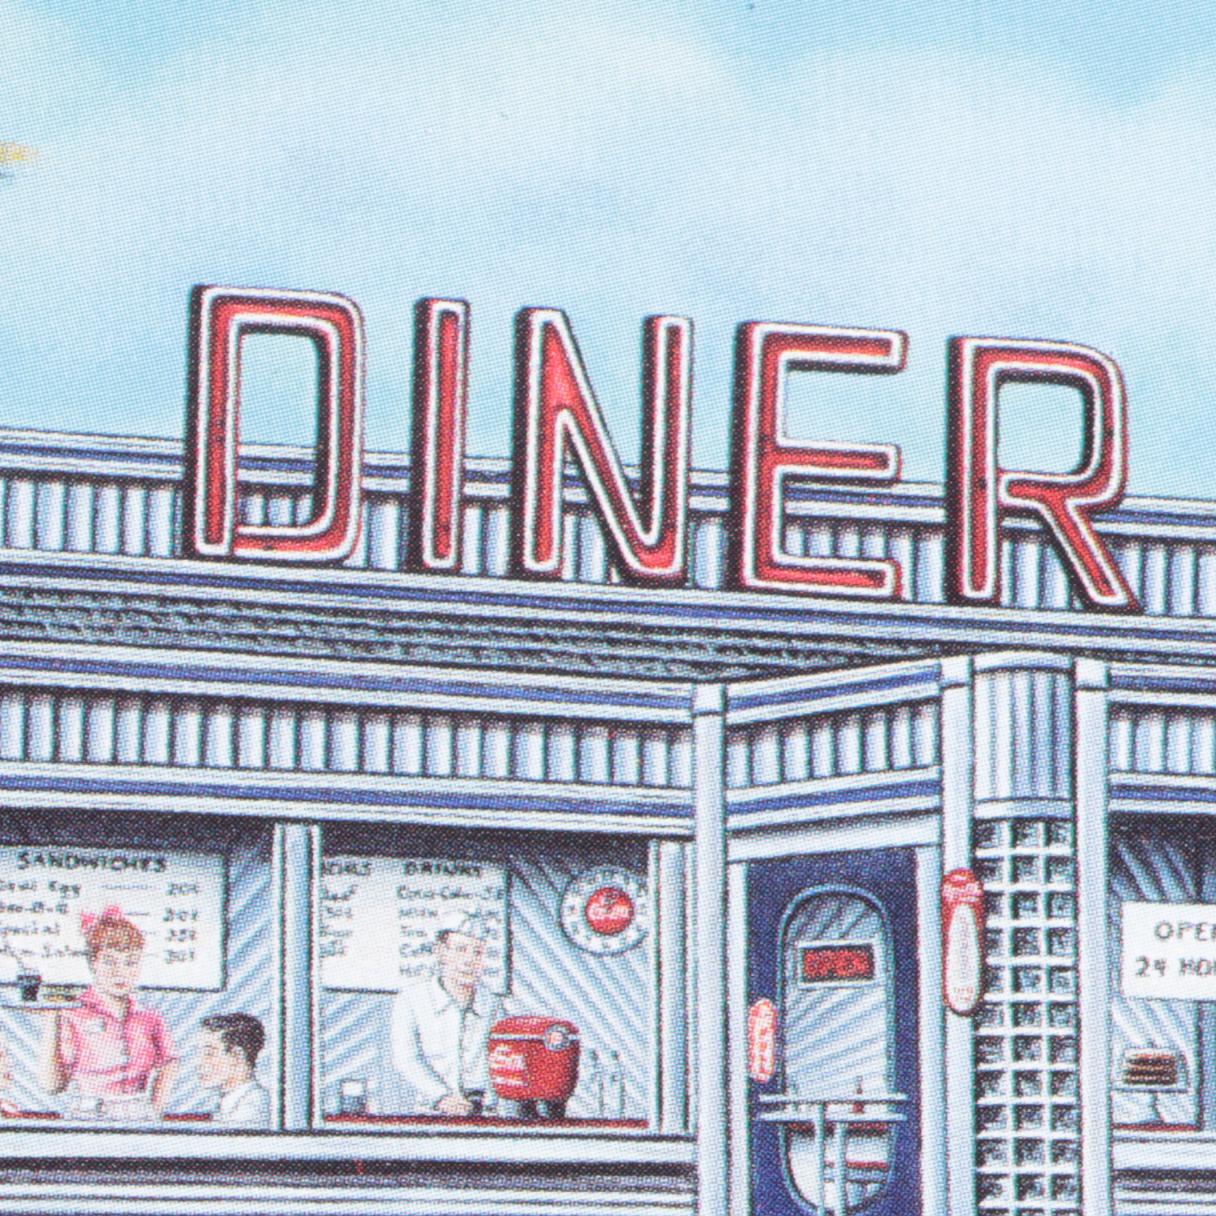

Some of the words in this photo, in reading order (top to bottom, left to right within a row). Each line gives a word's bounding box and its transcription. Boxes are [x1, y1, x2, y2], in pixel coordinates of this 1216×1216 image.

[188, 284, 1143, 613] DINER
[16, 851, 167, 873] SANDWICHES
[403, 861, 482, 878] DRINKS
[1134, 955, 1167, 978] 24
